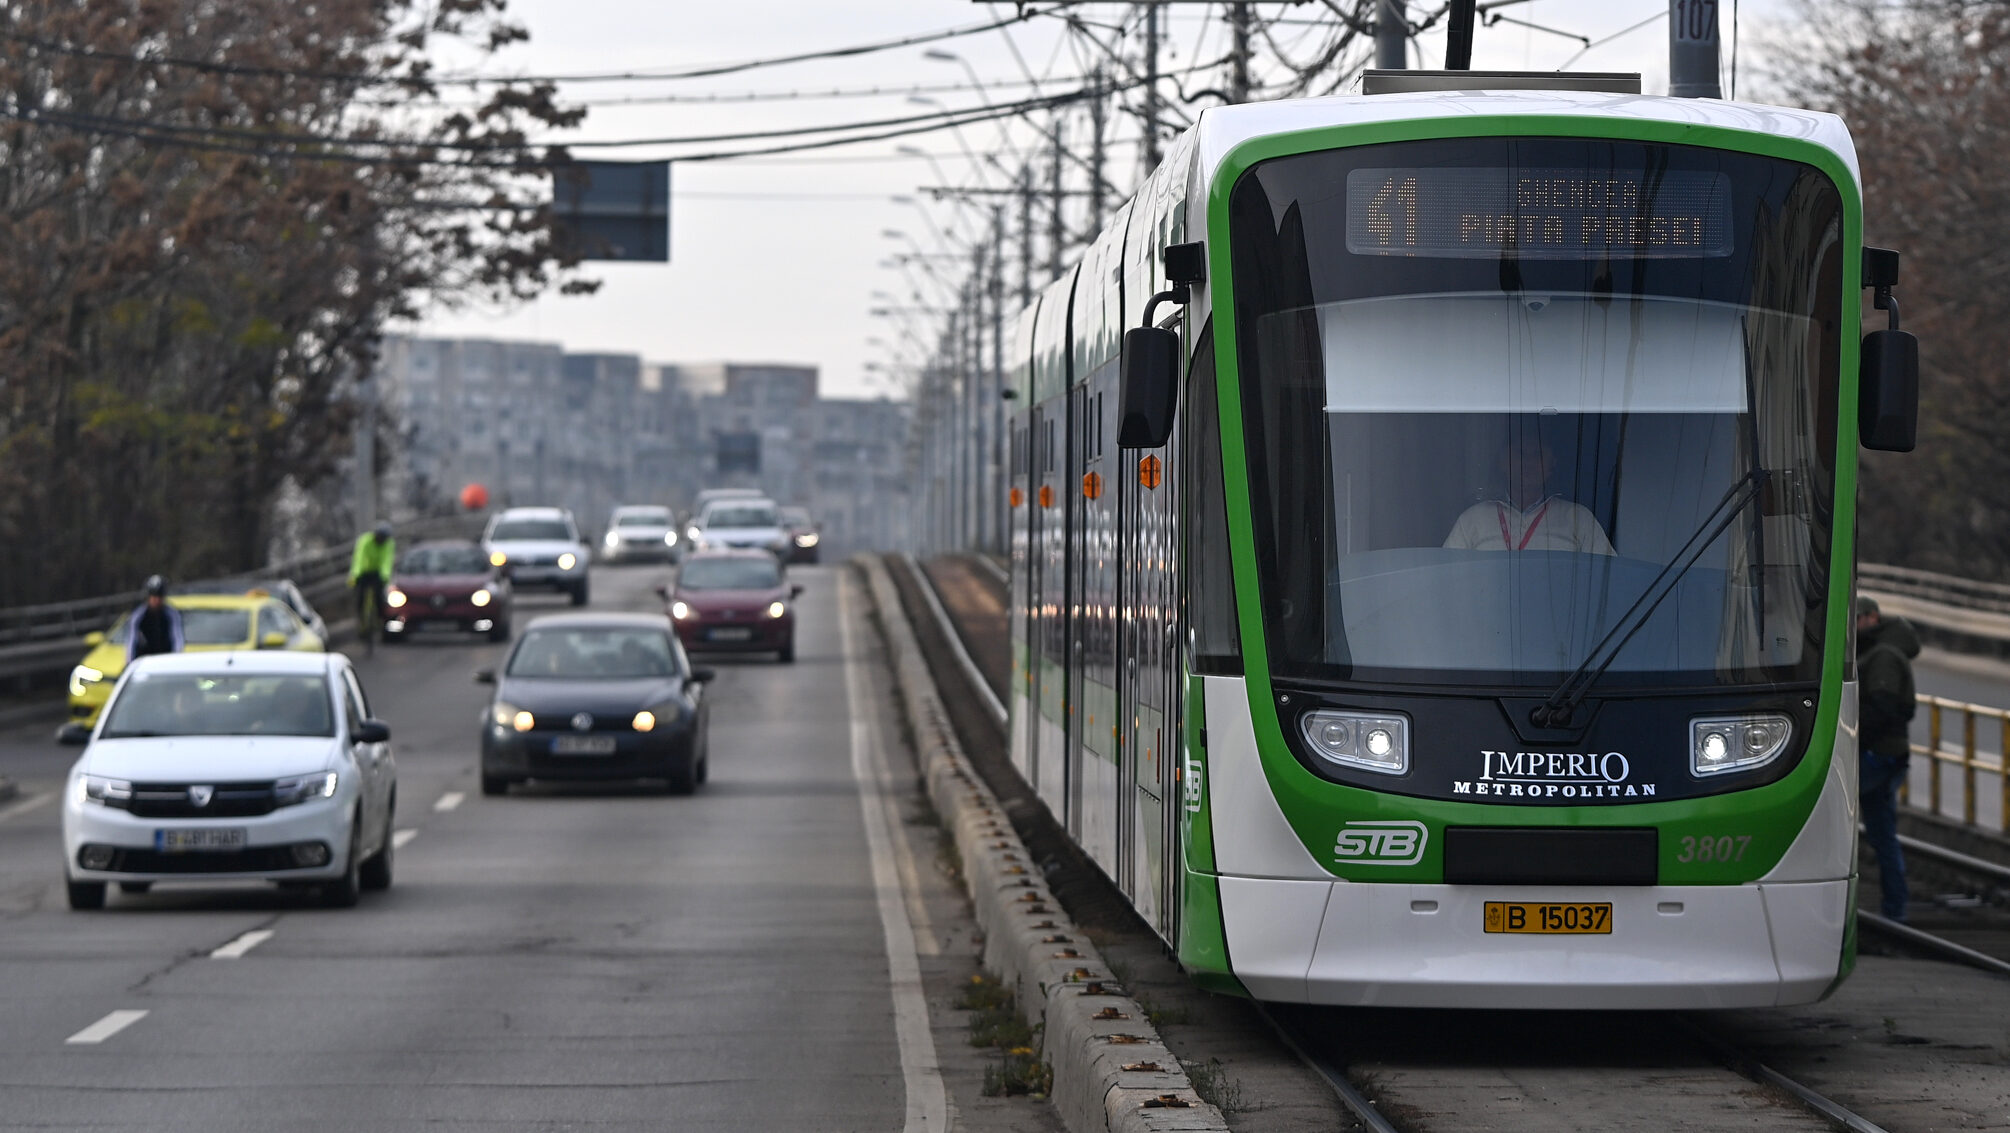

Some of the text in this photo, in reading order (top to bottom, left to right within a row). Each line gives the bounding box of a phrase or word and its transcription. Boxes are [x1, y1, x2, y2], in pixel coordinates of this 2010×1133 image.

[1677, 0, 1716, 40] 107
[1518, 179, 1636, 208] GHENCEA
[1367, 177, 1416, 245] 41
[1461, 214, 1700, 245] PIATA PRESEI
[1453, 781, 1656, 798] METROPOLITAN
[1334, 828, 1419, 857] STB
[1677, 835, 1752, 863] 3807
[1508, 905, 1610, 931] B 15037
